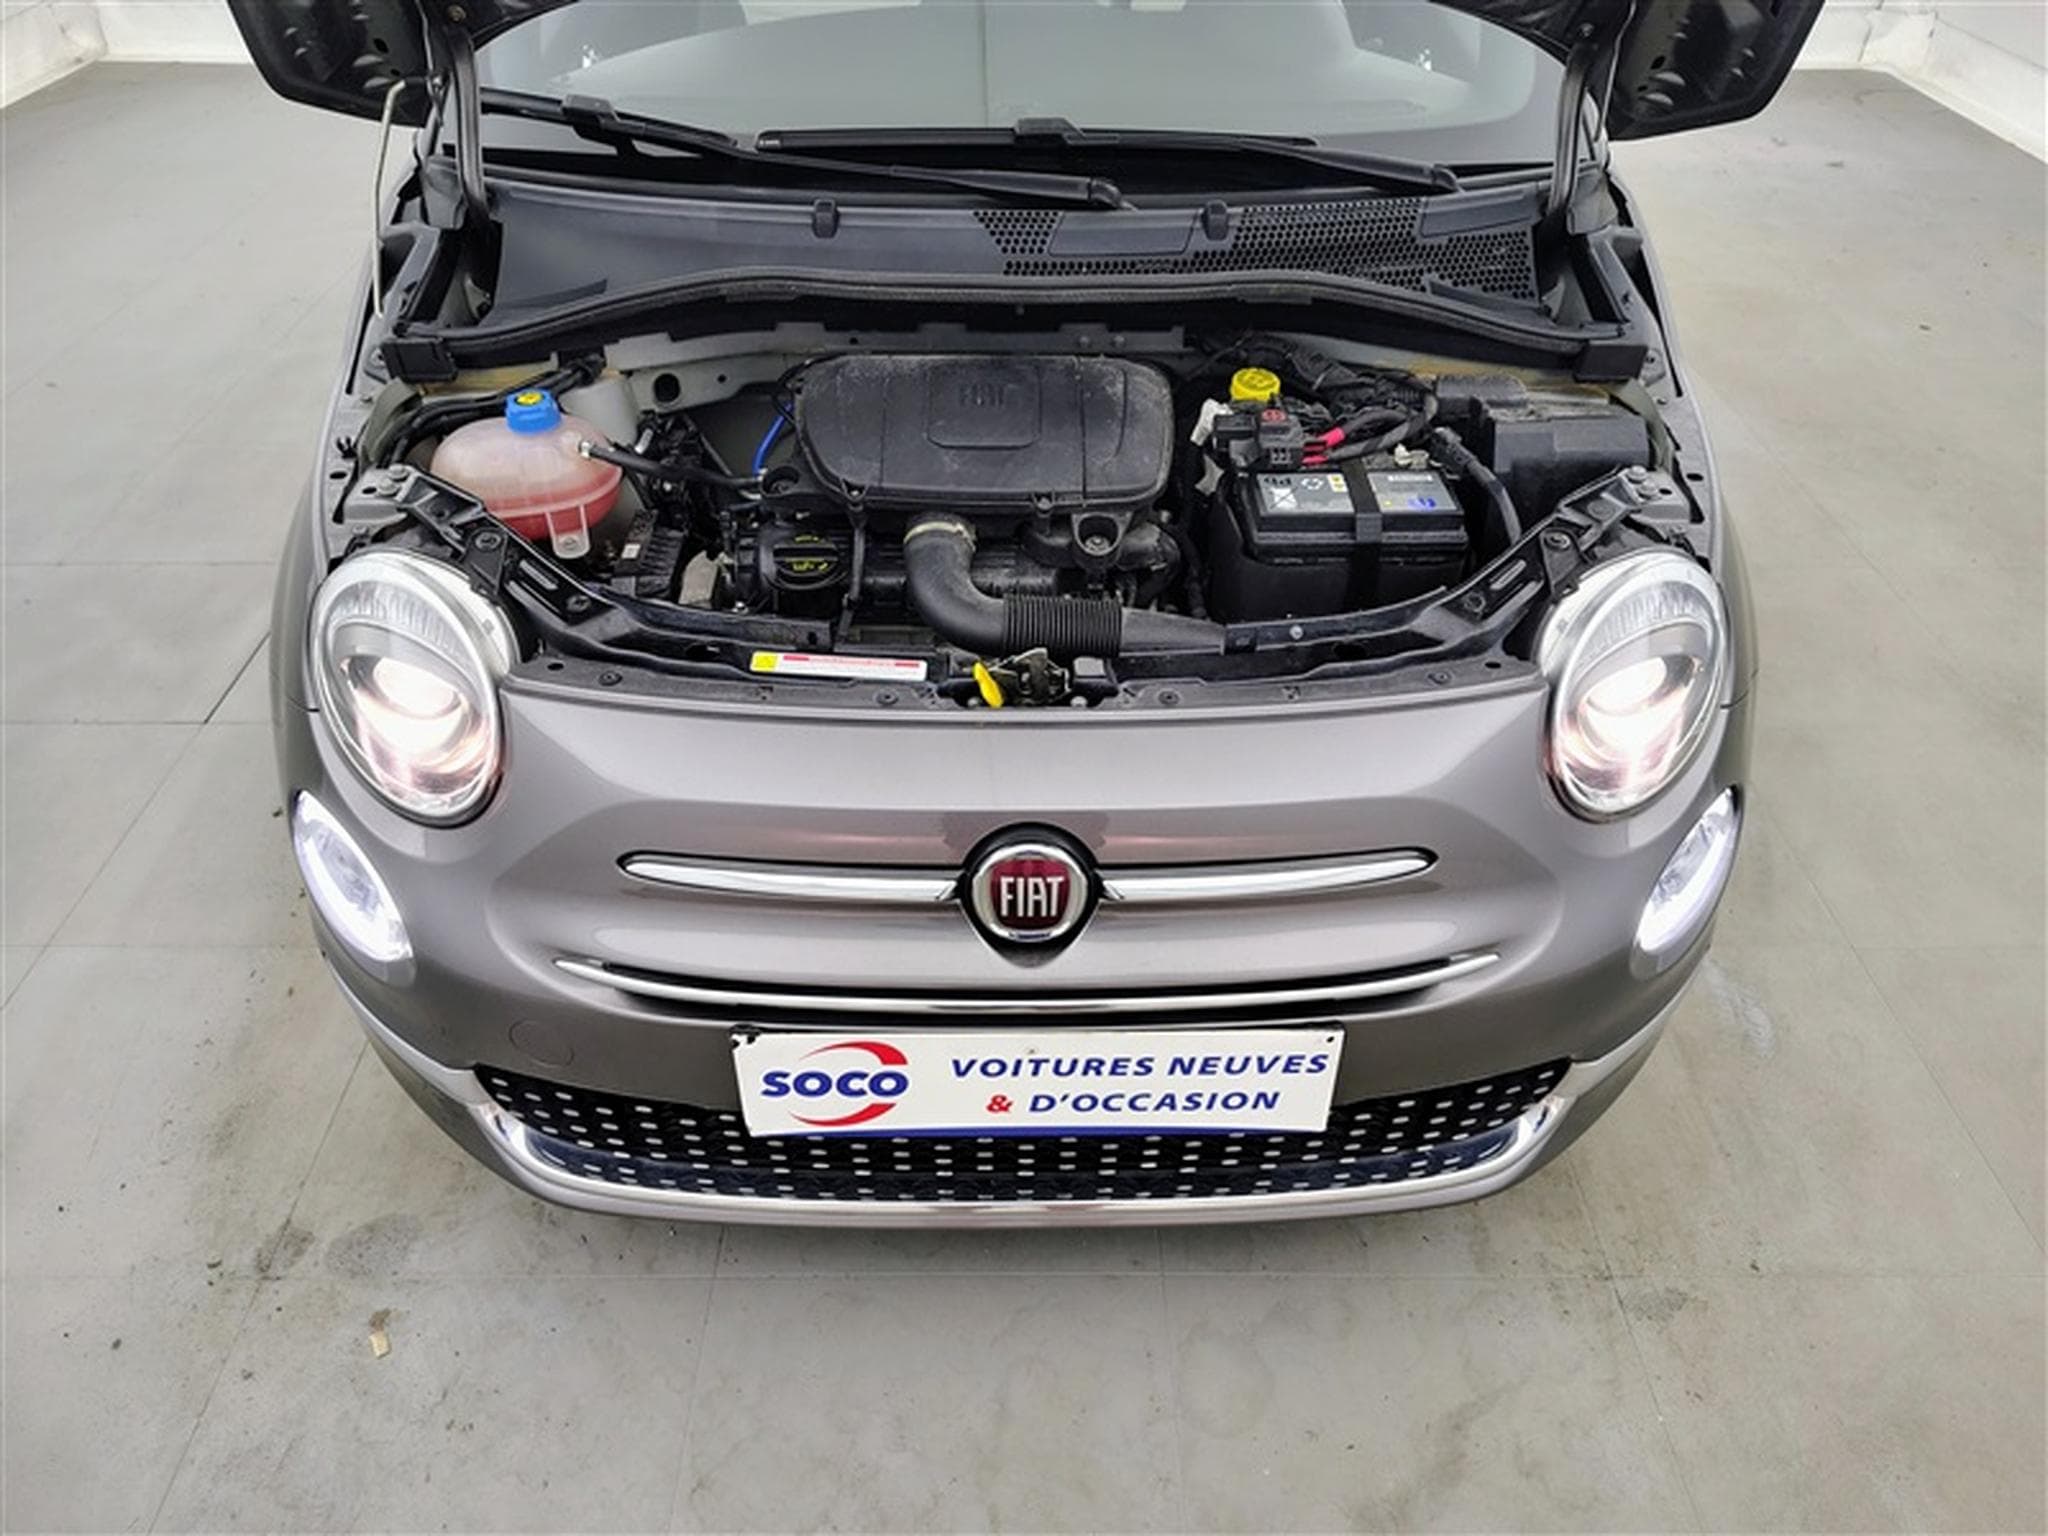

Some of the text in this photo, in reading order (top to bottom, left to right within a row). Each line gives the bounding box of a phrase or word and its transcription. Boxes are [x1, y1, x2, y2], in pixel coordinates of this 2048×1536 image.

[1001, 876, 1065, 918] FIAT
[952, 1054, 1329, 1078] VOITURES NEUVES
[761, 1071, 909, 1097] SOCO
[986, 1092, 1280, 1113] & D'OCCASION
